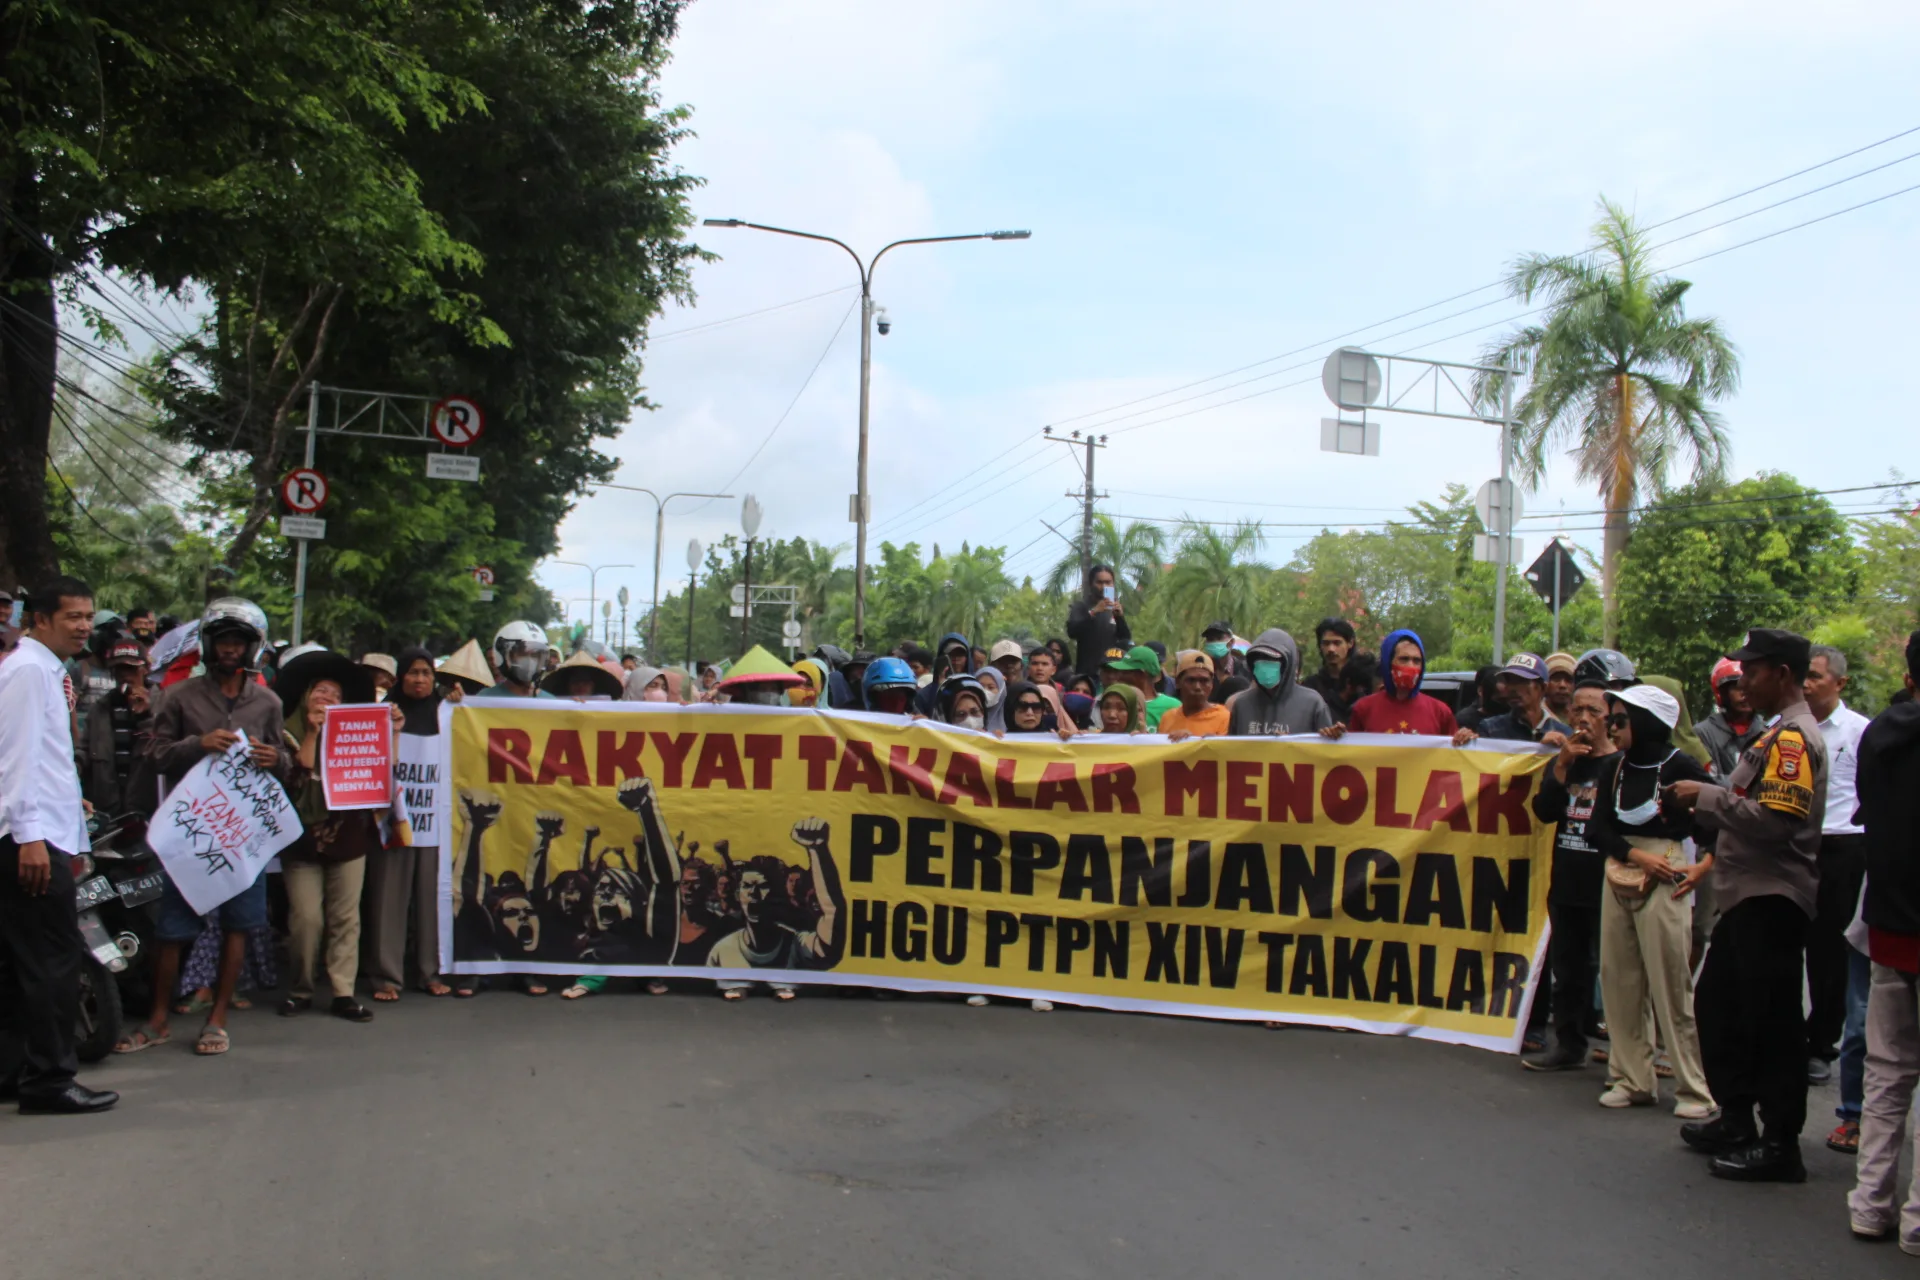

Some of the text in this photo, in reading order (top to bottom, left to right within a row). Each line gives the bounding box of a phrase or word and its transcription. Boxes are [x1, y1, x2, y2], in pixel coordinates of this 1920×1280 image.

[1511, 655, 1533, 667] FILA
[339, 720, 377, 731] TANAH
[335, 732, 379, 743] ADALAH
[334, 744, 381, 756] NYAWA,
[328, 756, 387, 768] KAU REBUT
[343, 769, 373, 780] KAMI
[397, 762, 440, 784] BALIK
[487, 728, 1532, 836] RAKYAT TAKALAR MENOLAK
[333, 781, 385, 793] MENYALA
[405, 788, 433, 808] NAH
[202, 781, 255, 849] TANAH
[409, 812, 435, 833] YAT
[168, 799, 235, 877] RAKYAT
[849, 814, 1531, 934] PERPANJANGAN
[850, 899, 1532, 1019] HGU PTPN XIV TAKALAR
